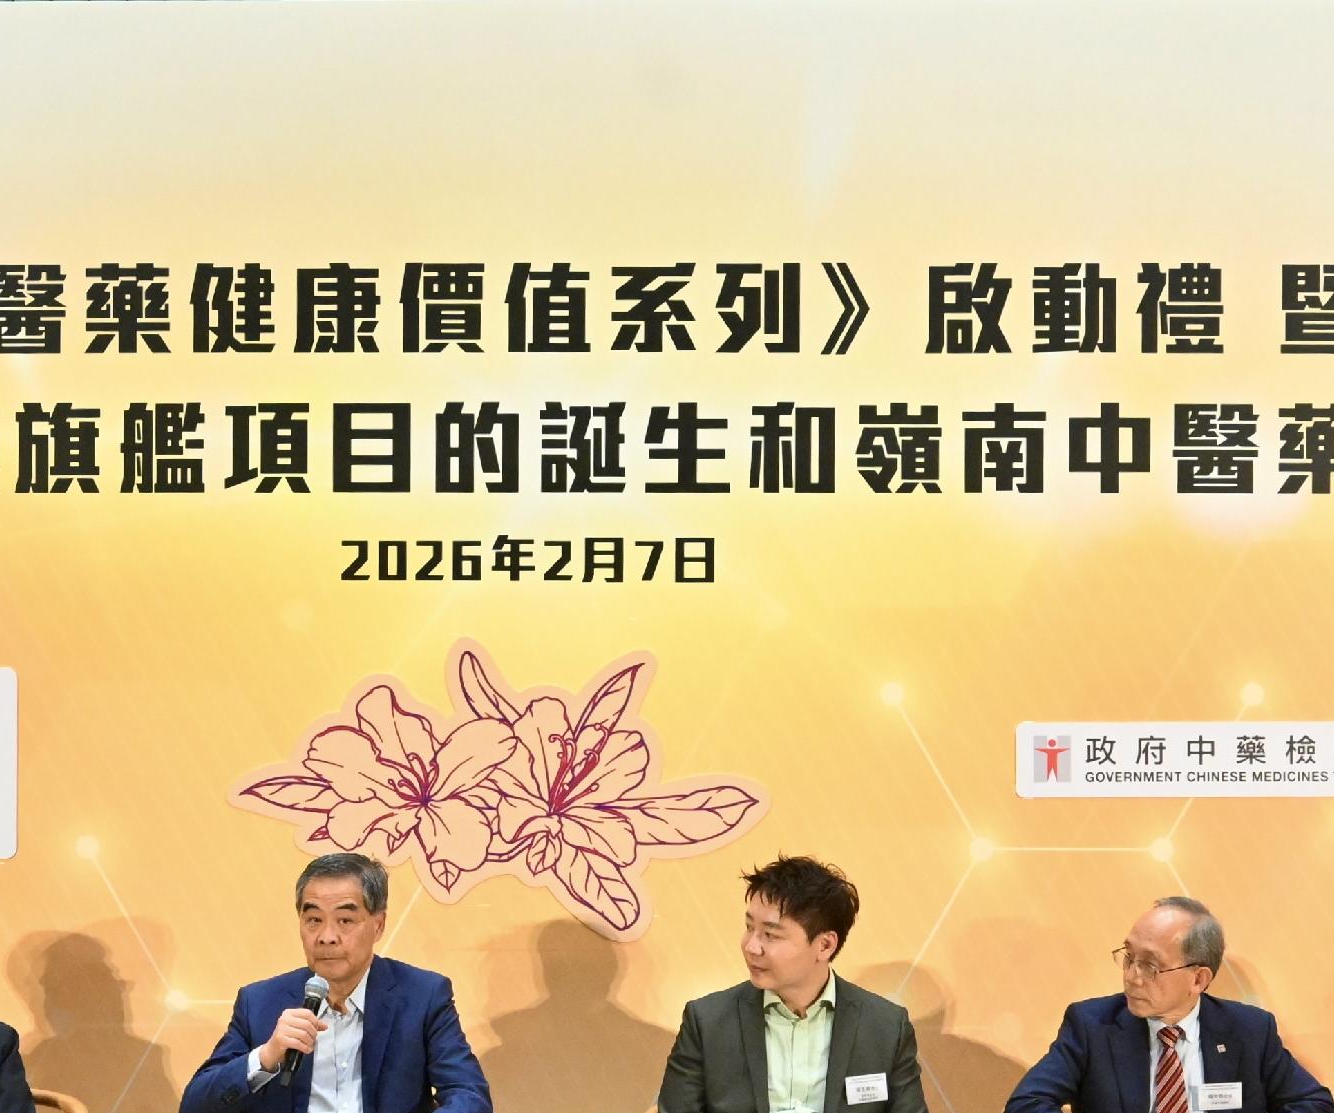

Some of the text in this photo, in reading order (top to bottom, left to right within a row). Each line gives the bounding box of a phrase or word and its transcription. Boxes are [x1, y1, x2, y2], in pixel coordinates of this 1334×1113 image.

[340, 534, 715, 583] 2026年2月7日
[1085, 770, 1182, 782] GOVERNMENT
[1186, 770, 1246, 782] CHINESE
[1252, 770, 1328, 782] MEDICINES
